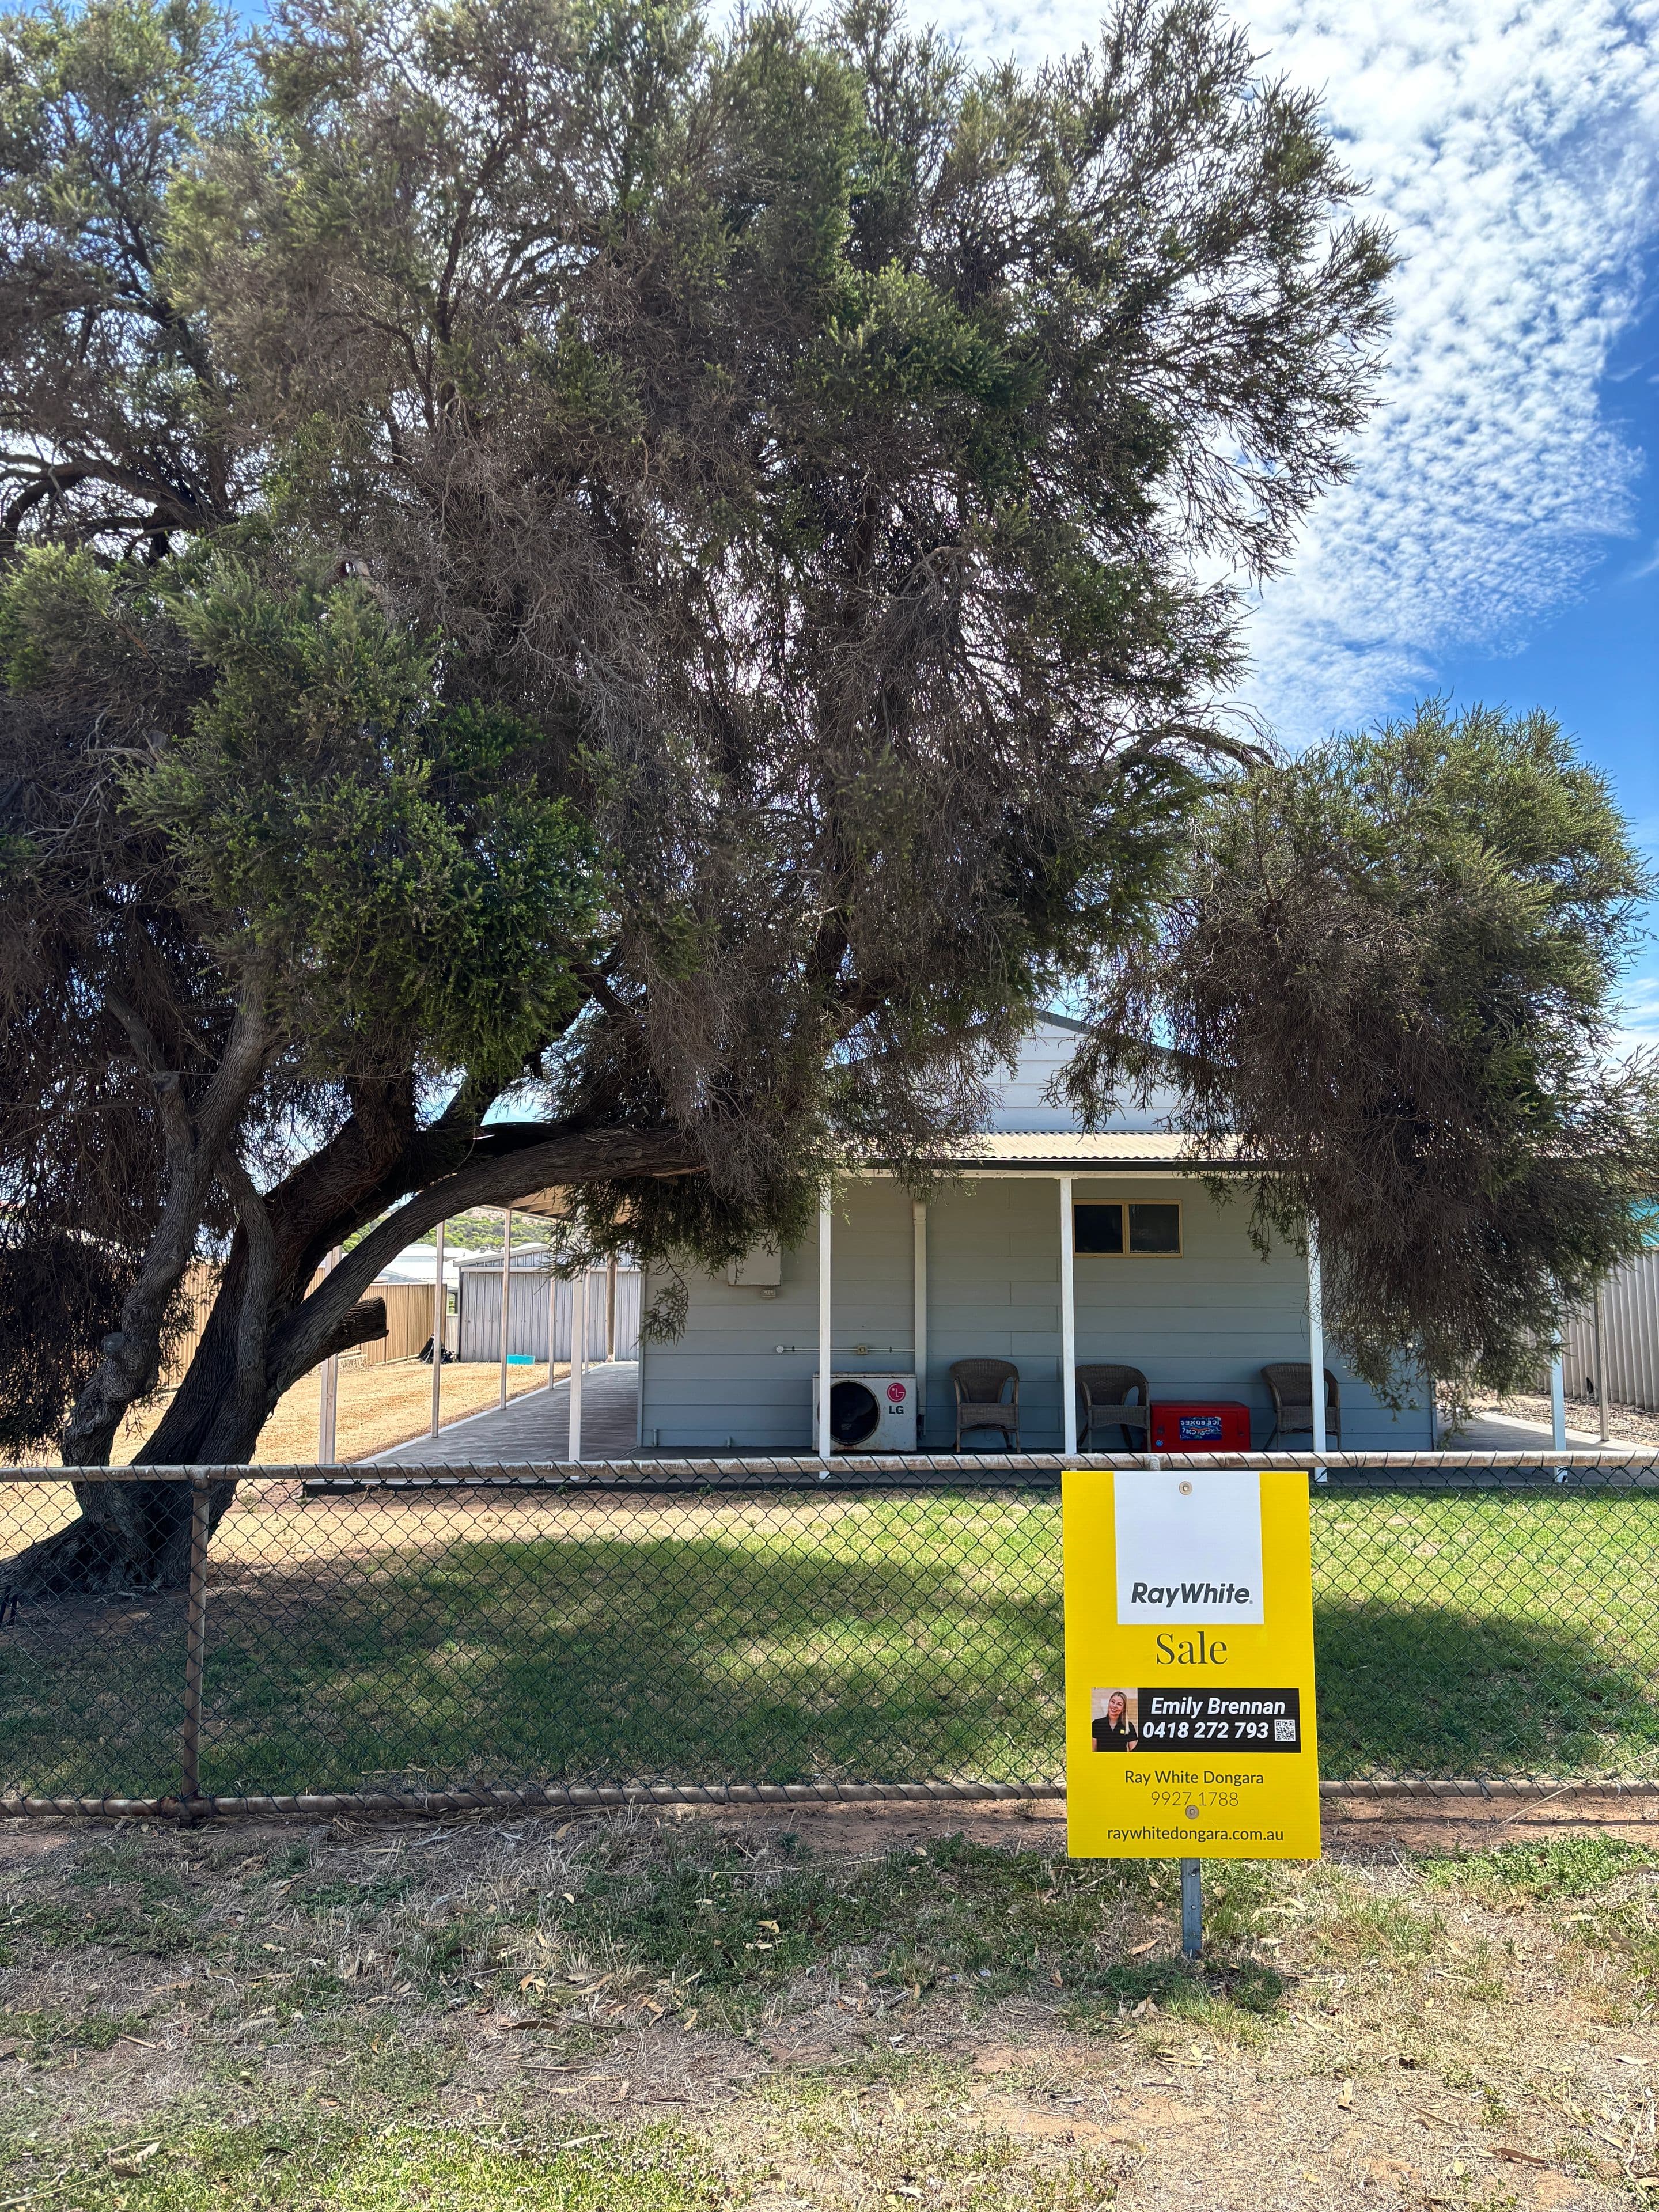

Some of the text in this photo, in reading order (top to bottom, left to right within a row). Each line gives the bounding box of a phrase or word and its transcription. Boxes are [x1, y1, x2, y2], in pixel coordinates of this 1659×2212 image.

[889, 1405, 904, 1414] LG
[1157, 1631, 1227, 1664] Sale
[1151, 1697, 1285, 1718] Emily Brennan
[1143, 1722, 1268, 1738] 0418 272 793
[1126, 1771, 1263, 1786] Ray White Dongara
[1151, 1791, 1238, 1806] 9927 1788
[1107, 1826, 1283, 1842] raywhitedongara.com.au
